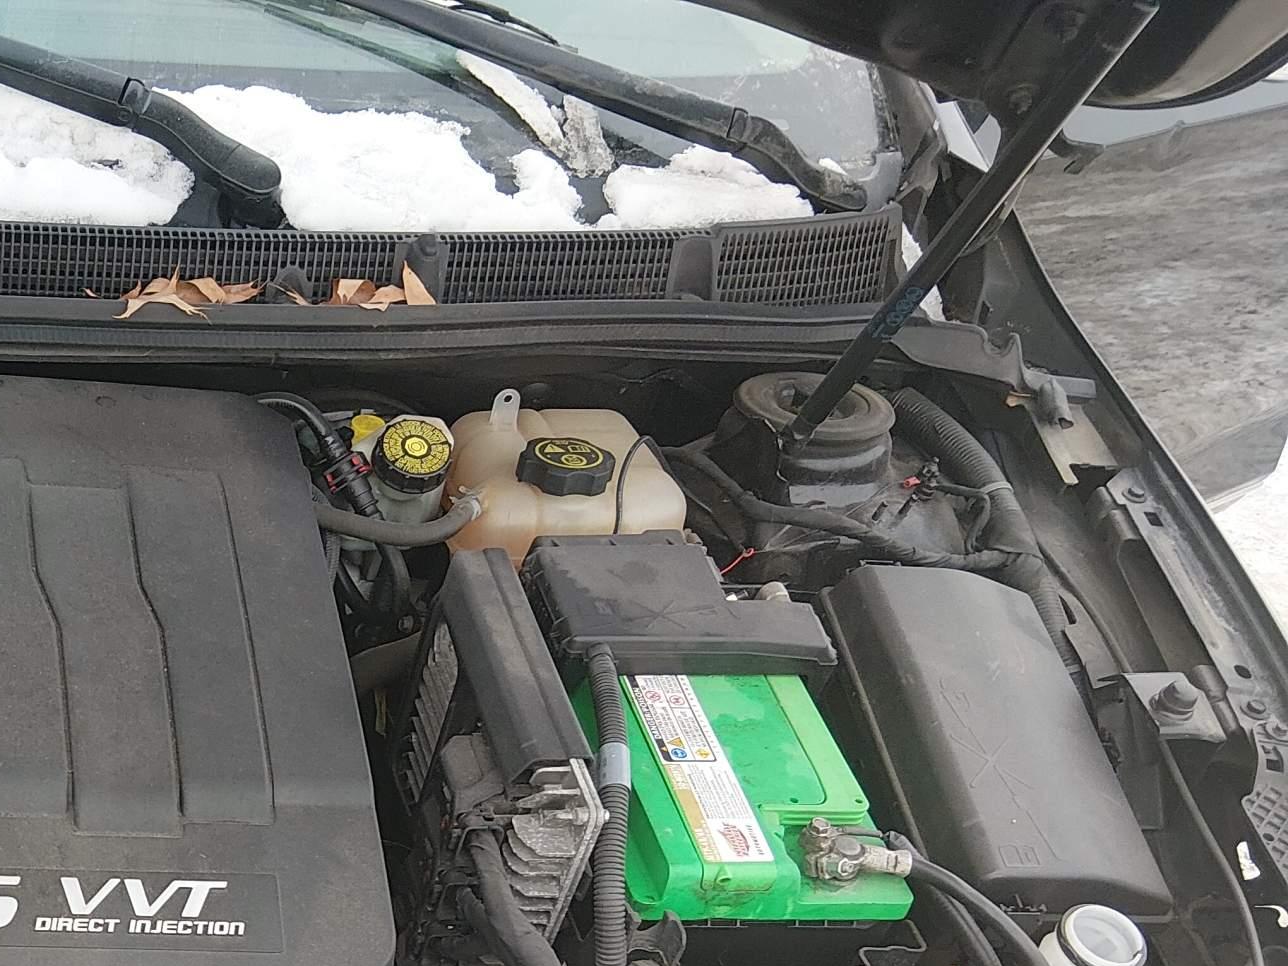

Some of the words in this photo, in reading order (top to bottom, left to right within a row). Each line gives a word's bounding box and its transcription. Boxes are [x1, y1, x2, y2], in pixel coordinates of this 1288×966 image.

[60, 876, 228, 918] VVT
[34, 916, 121, 933] DIRECT
[128, 919, 245, 937] INJECTION
